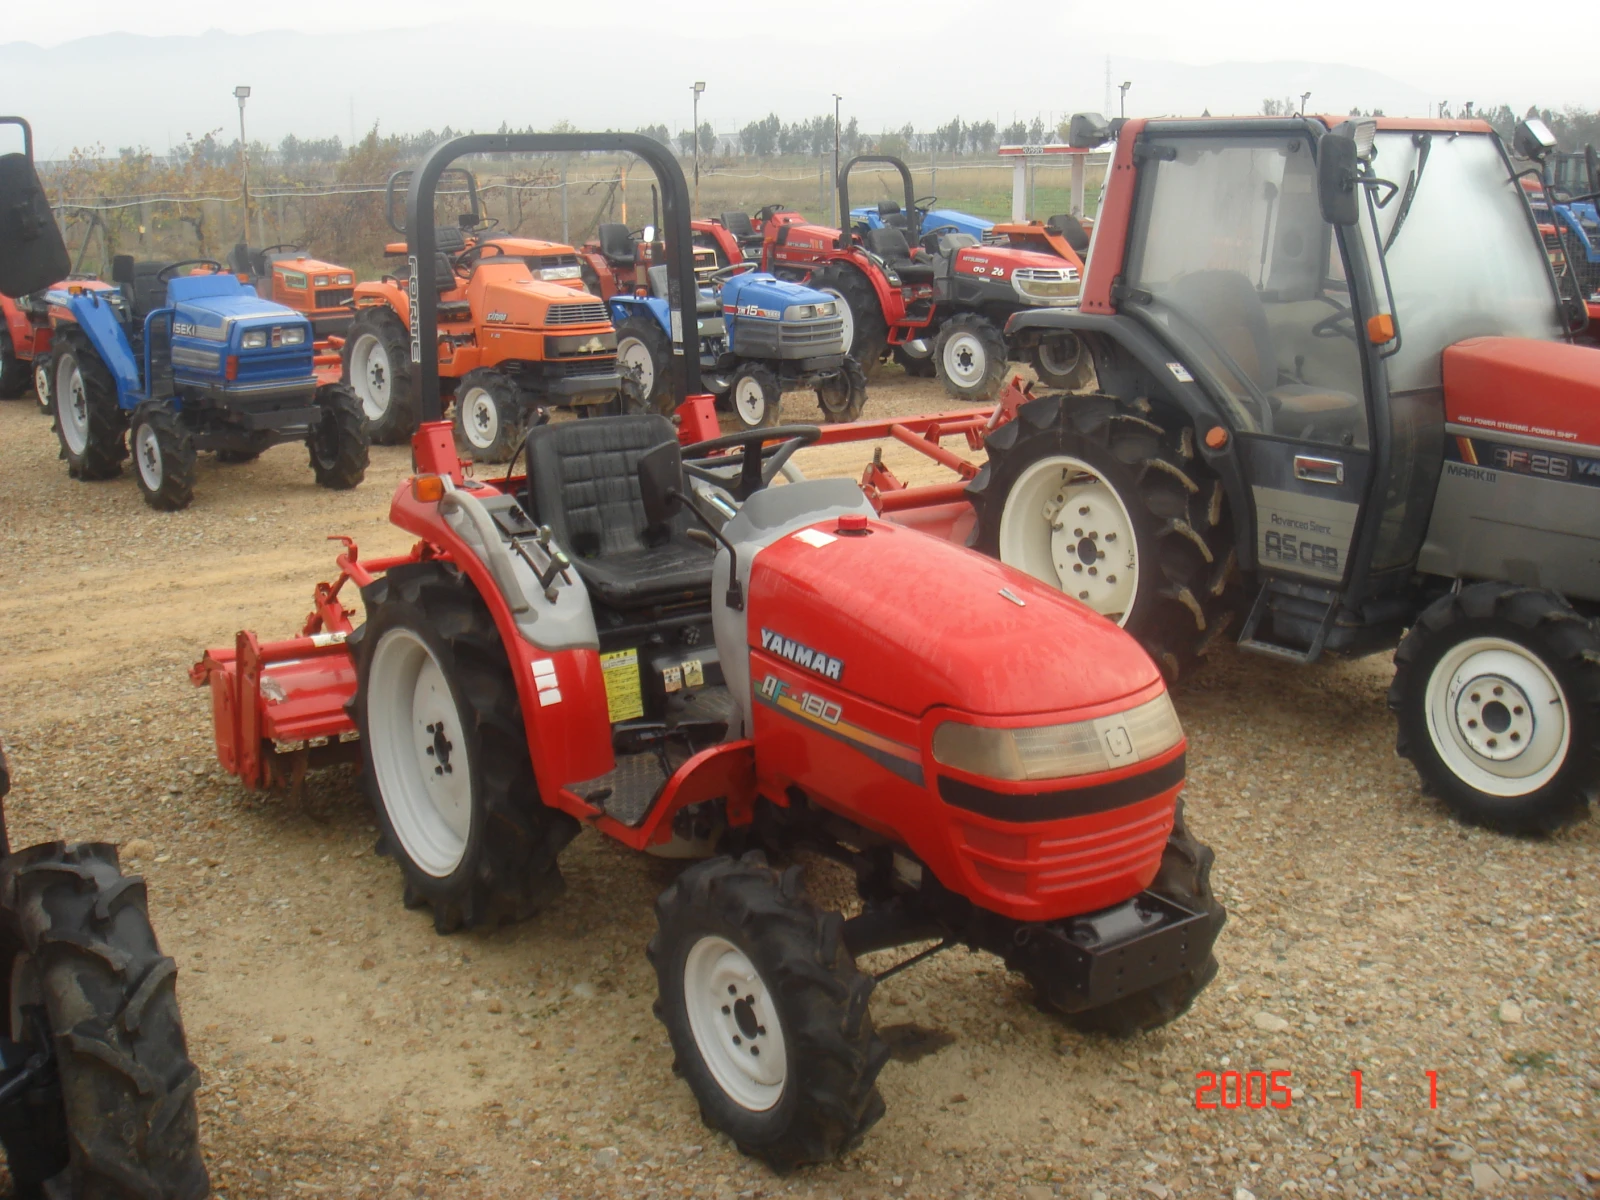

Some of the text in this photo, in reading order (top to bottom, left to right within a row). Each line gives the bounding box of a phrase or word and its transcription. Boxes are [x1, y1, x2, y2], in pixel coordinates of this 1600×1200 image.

[991, 267, 1005, 277] 26
[172, 322, 196, 336] ISEKI
[408, 255, 421, 362] FORTE
[1271, 513, 1309, 531] Advanced
[1265, 529, 1338, 572] AS CAB
[760, 627, 844, 682] YANMAR
[760, 674, 843, 725] AF-180
